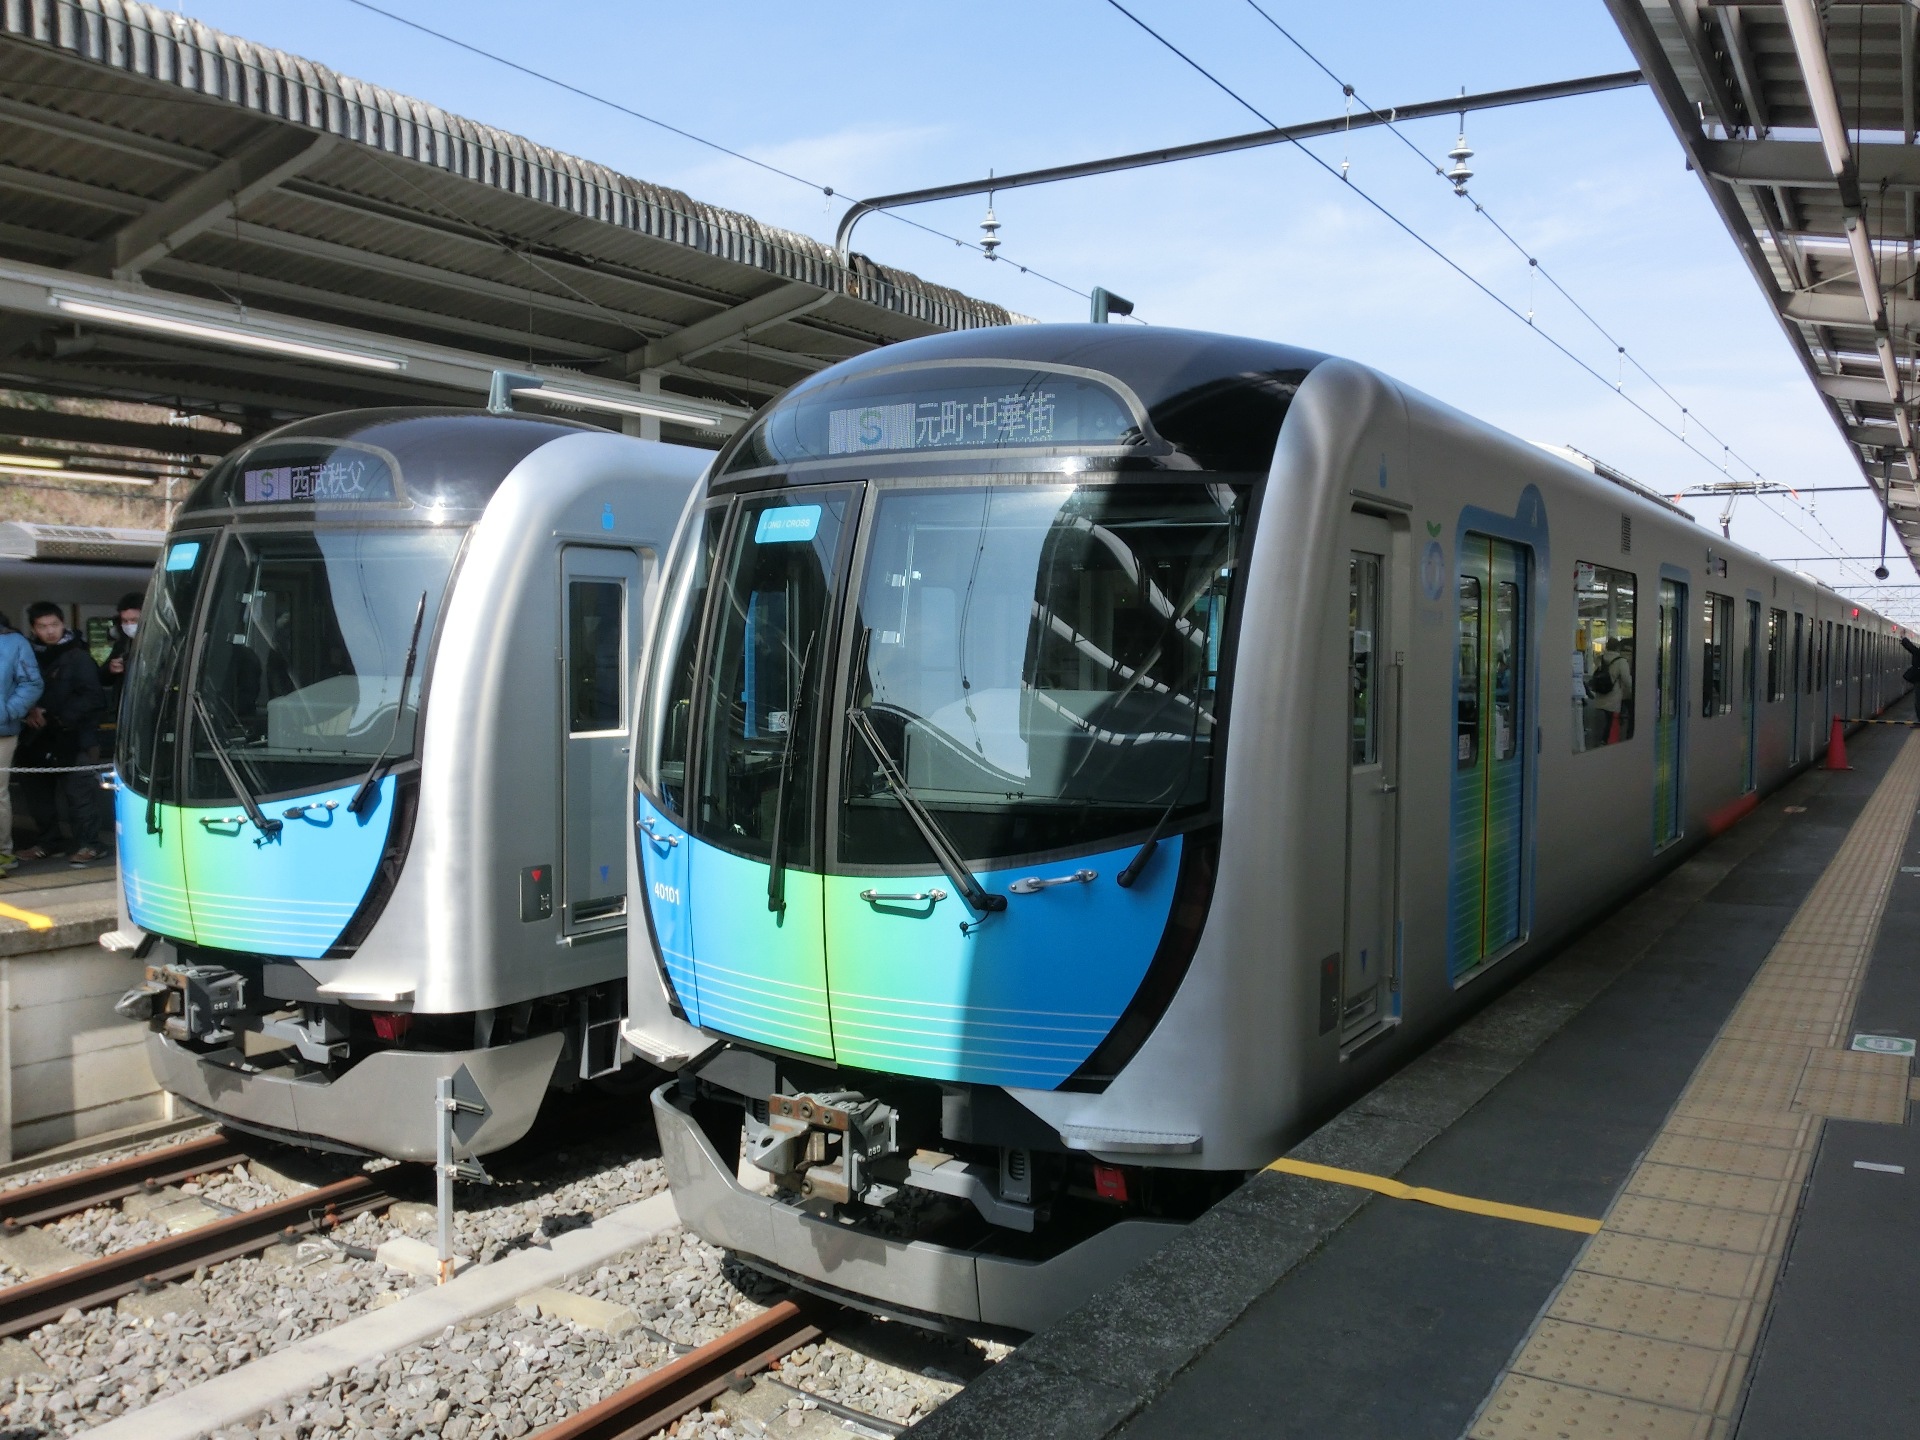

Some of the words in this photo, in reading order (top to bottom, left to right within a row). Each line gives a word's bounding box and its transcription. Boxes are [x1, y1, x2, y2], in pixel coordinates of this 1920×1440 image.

[291, 461, 365, 497] 西武秩父
[786, 519, 811, 528] CROSS
[654, 881, 680, 905] 40101
